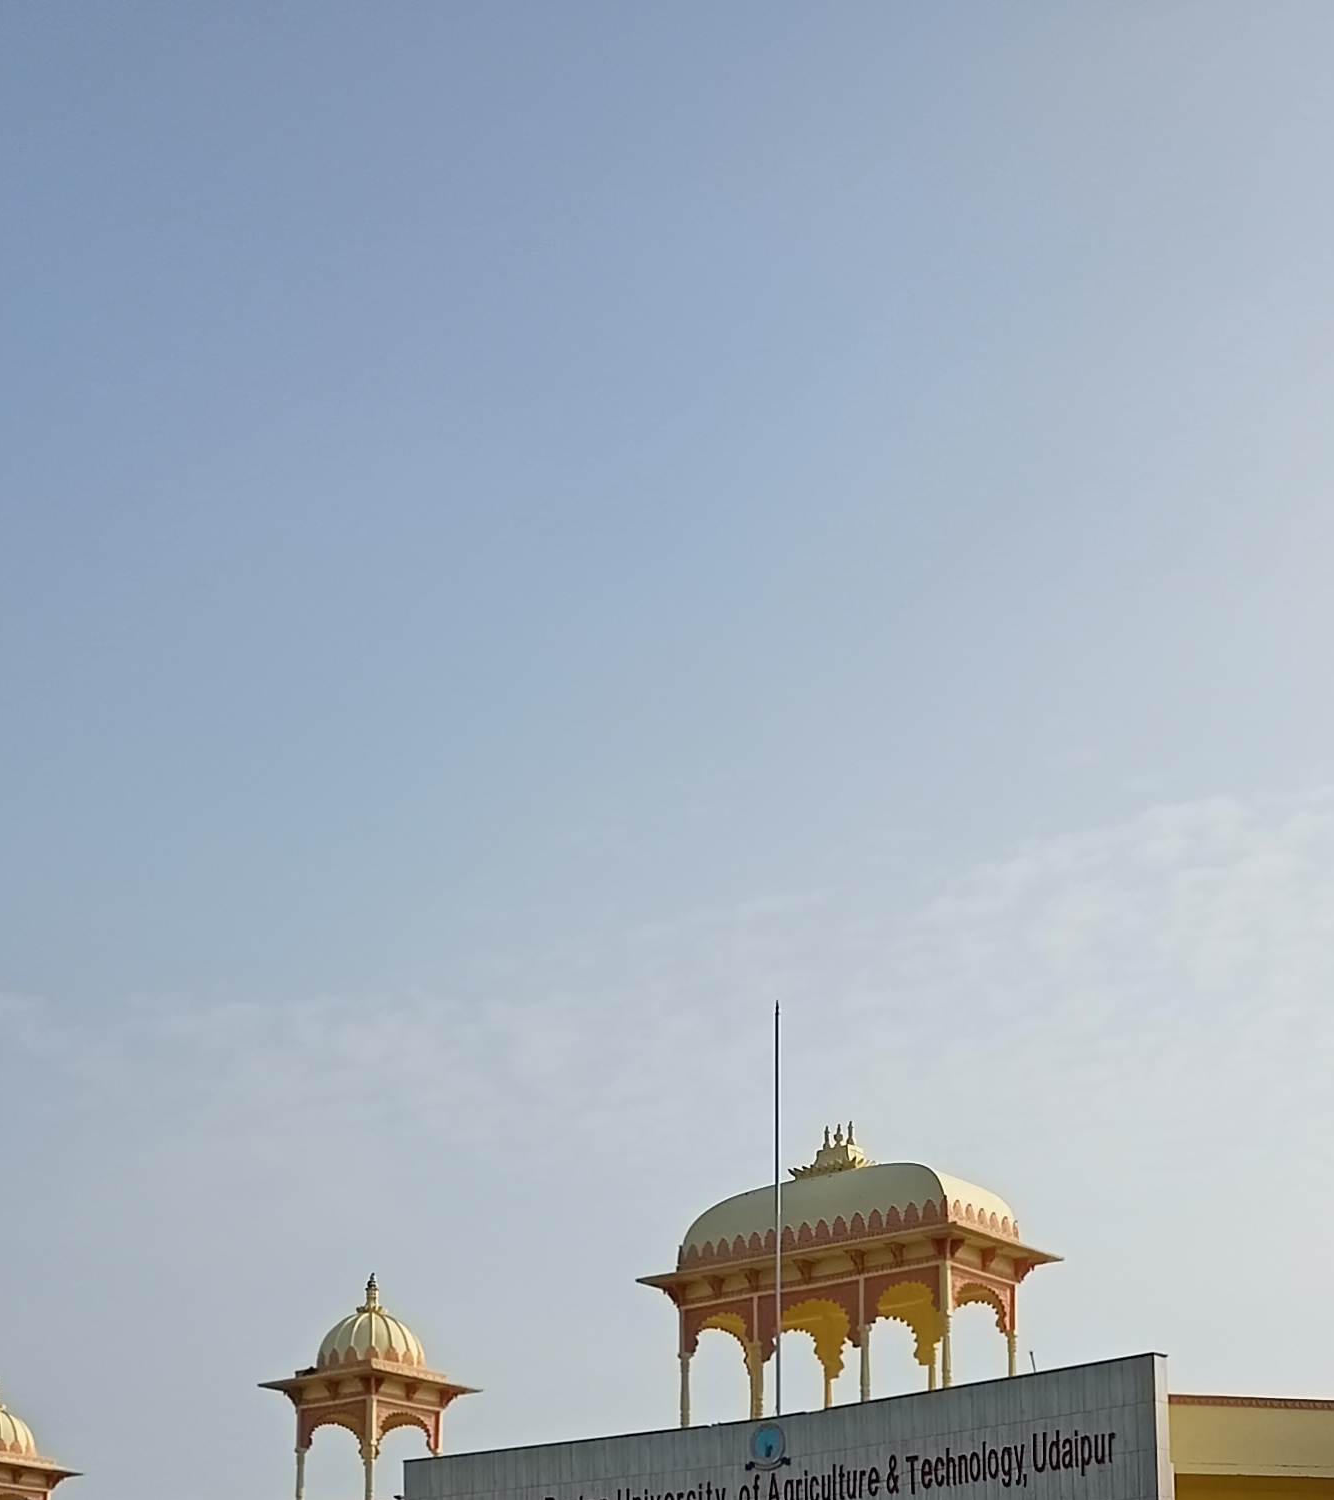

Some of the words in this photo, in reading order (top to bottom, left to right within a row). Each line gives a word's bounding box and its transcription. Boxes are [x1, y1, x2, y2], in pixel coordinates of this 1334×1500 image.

[886, 1454, 900, 1494] &
[905, 1441, 1027, 1488] Technology,
[1032, 1429, 1116, 1477] Udaipur
